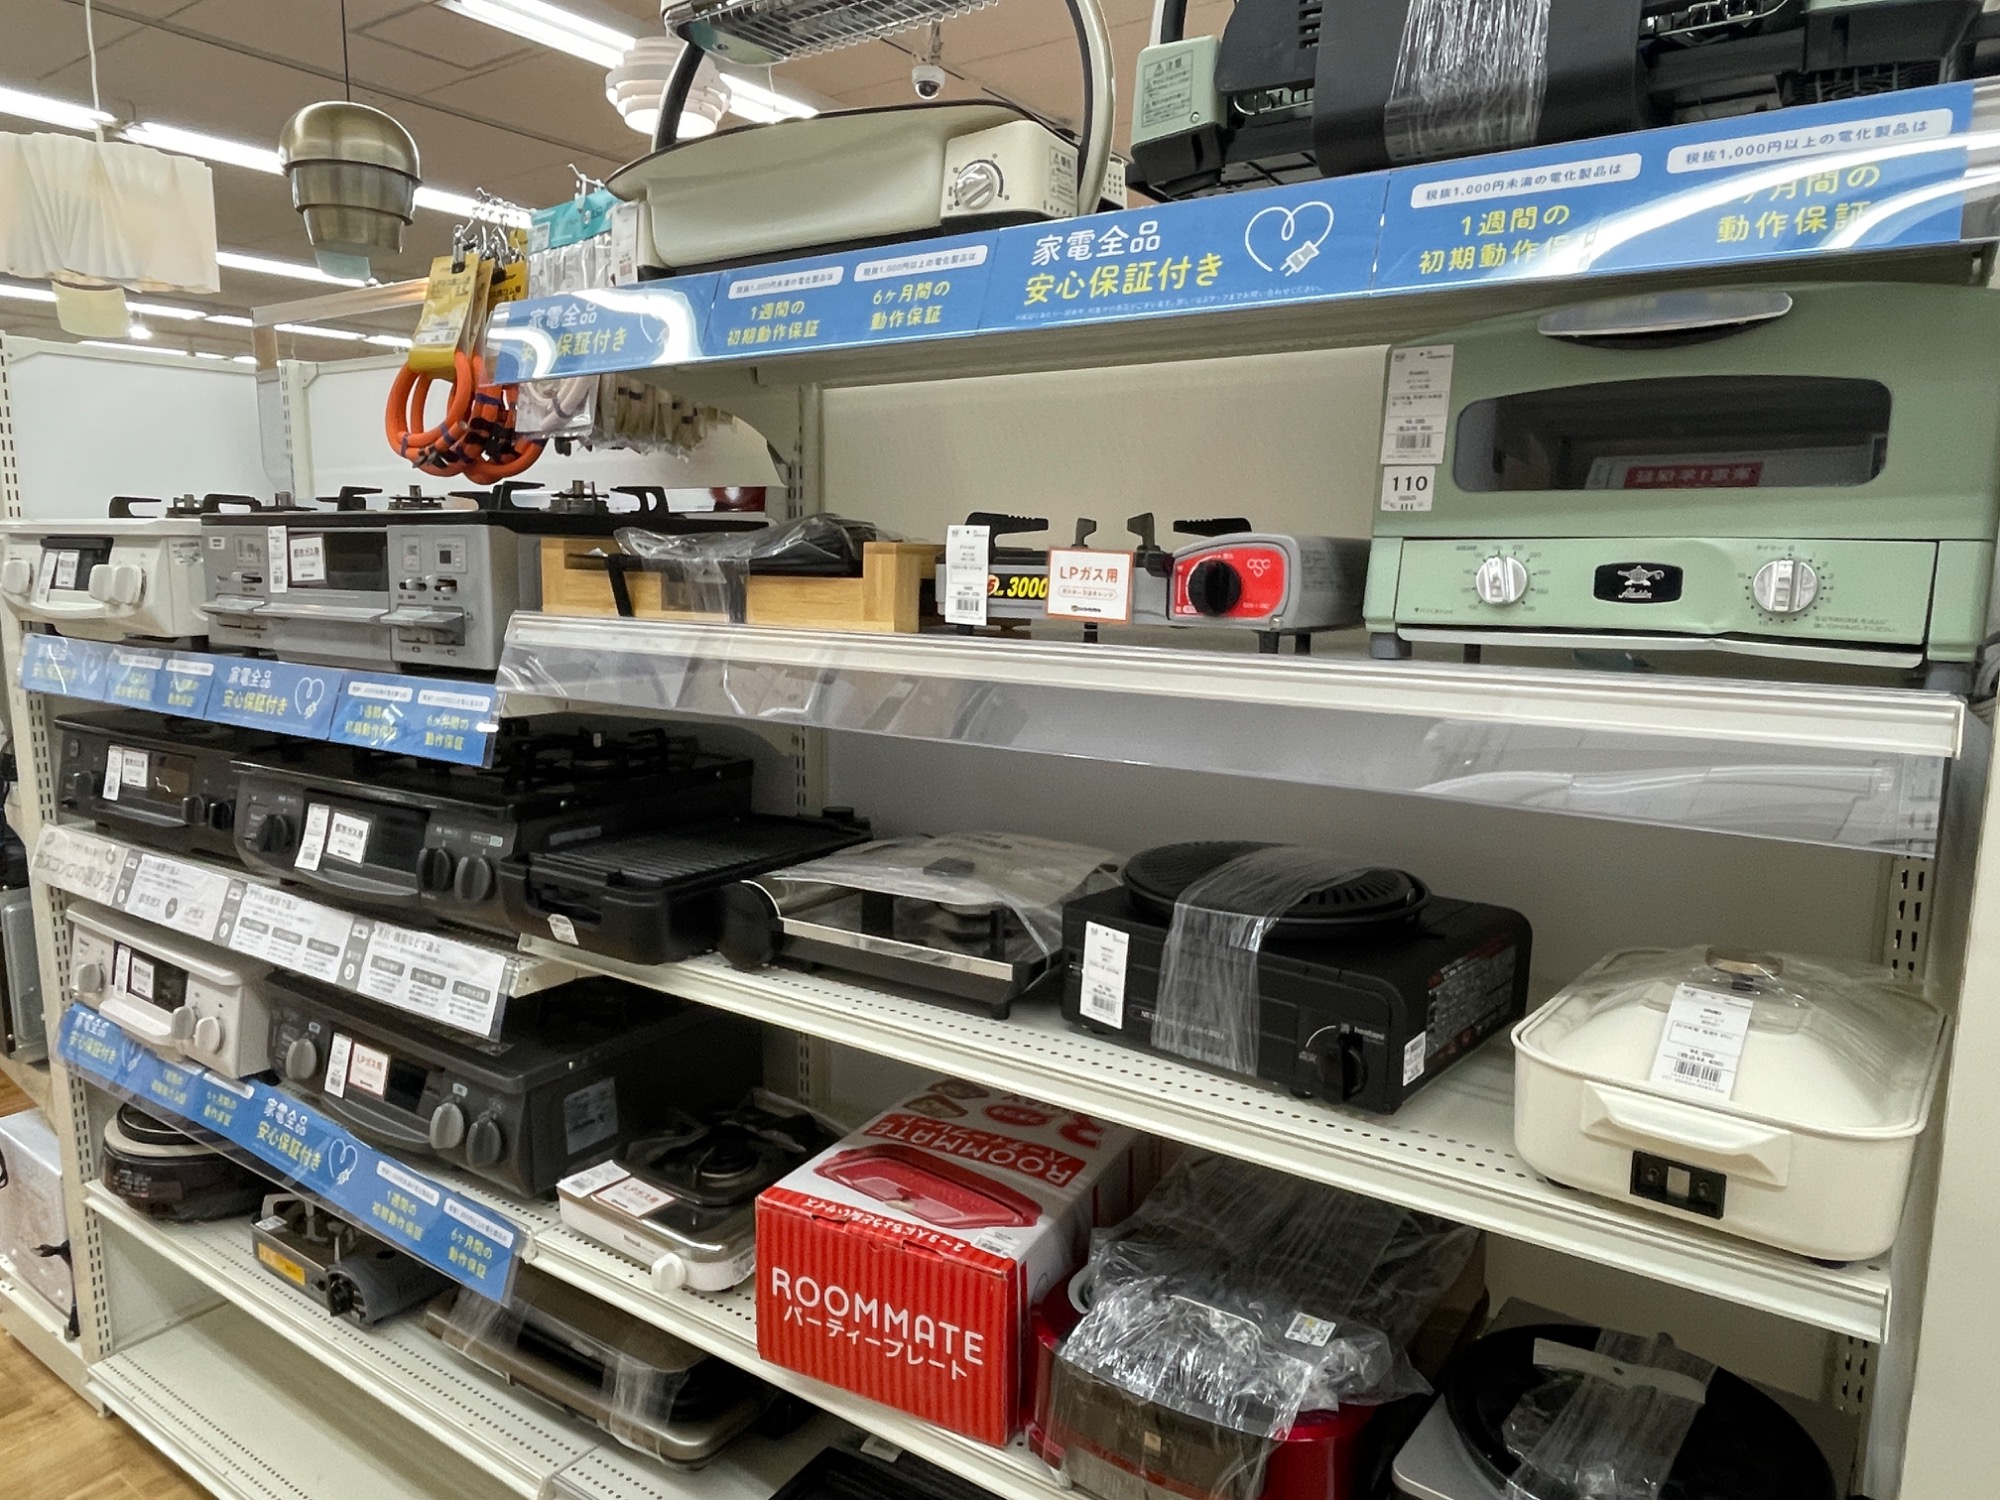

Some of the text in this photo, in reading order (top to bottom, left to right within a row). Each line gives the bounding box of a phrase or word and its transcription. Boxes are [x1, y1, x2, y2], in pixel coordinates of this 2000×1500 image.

[1686, 120, 1929, 164] 税抜1,000円以上の電化製品は
[1426, 163, 1622, 200] 税抜1,000円未満の電化製品は
[1461, 203, 1570, 236] 1週間の
[1031, 220, 1161, 266] 家電全品
[872, 280, 951, 306] 6ヶ月間の
[1024, 252, 1224, 306] 安心保証付き
[529, 302, 598, 329] 家電全品
[750, 299, 806, 321] 1週間の
[869, 305, 943, 331] 動作保証
[726, 319, 820, 346] 初期動作保証
[1393, 476, 1429, 492] 110
[1007, 576, 1049, 598] 3000
[1059, 567, 1119, 584] LPガス用
[264, 1098, 308, 1136] 家電全品
[868, 1120, 1072, 1185] ROOMMATE
[771, 1266, 984, 1366] ROOMMATE
